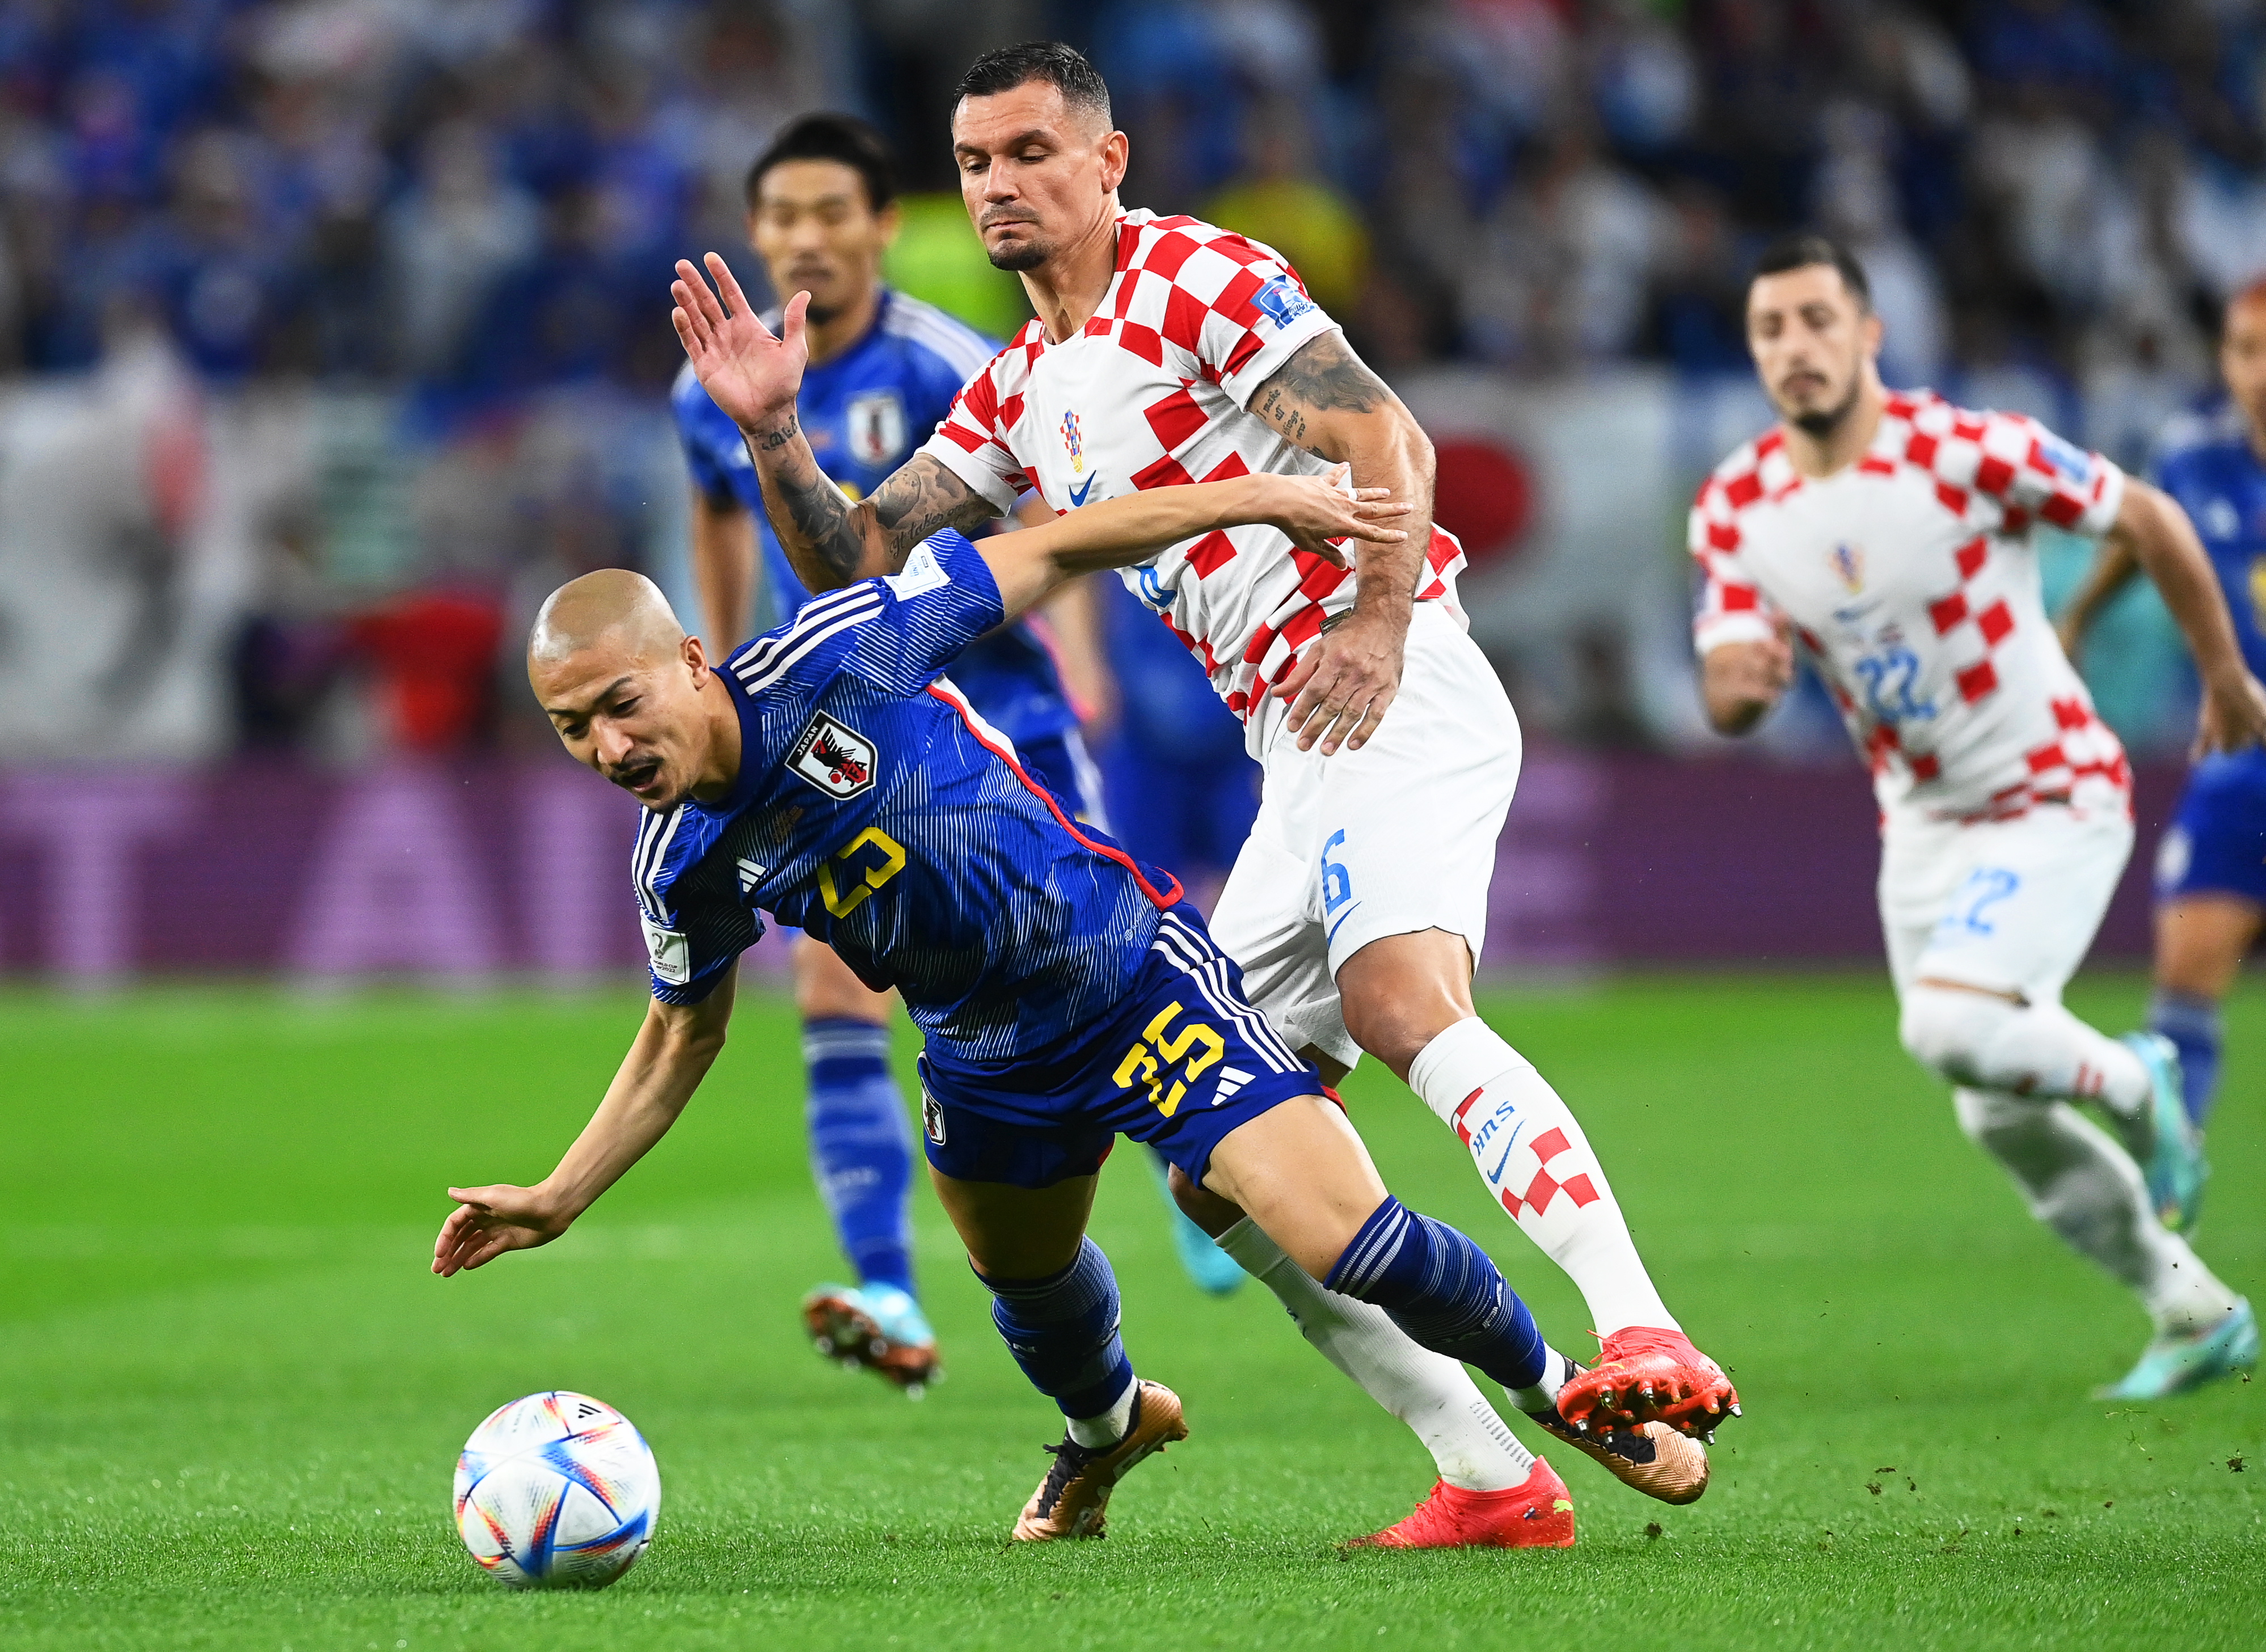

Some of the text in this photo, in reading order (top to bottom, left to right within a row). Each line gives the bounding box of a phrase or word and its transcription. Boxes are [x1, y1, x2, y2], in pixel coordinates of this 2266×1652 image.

[1263, 389, 1281, 413] make
[1855, 648, 1937, 720] 22
[797, 726, 818, 755] JAPAN
[1321, 828, 1351, 918] 6
[1112, 1000, 1225, 1118] 25
